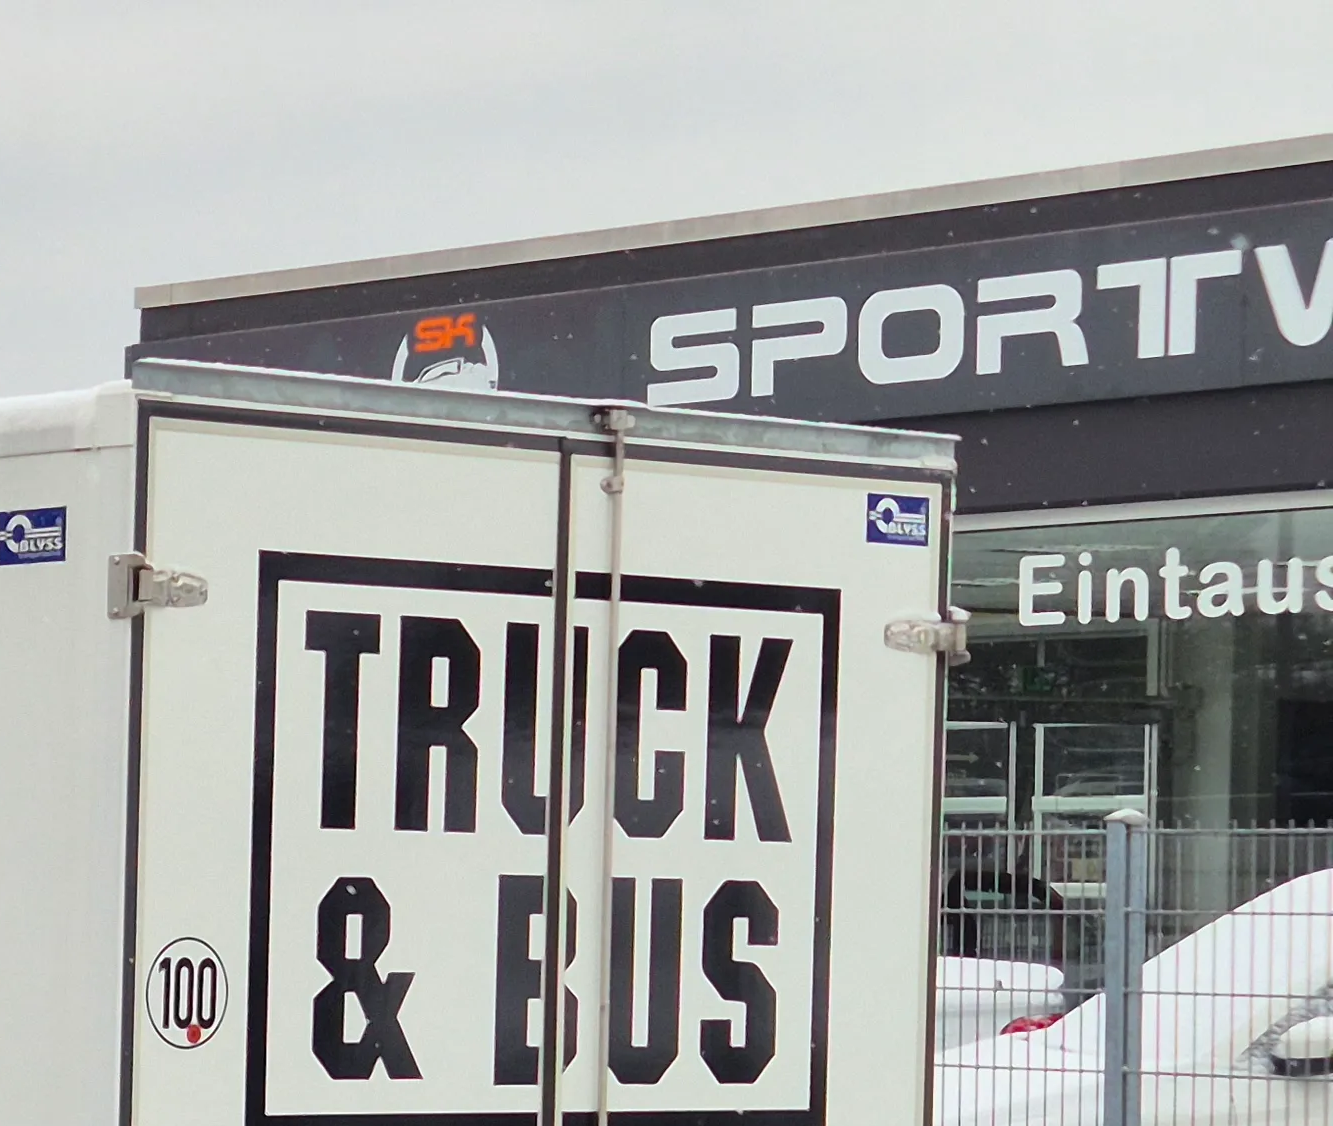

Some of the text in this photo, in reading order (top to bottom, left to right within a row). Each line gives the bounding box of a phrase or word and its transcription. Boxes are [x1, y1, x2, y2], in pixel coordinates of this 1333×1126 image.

[414, 312, 477, 353] SK
[19, 536, 64, 553] BLYSS
[304, 610, 793, 843] TRUCK
[158, 957, 217, 1030] 100
[312, 874, 779, 1085] & BUS
